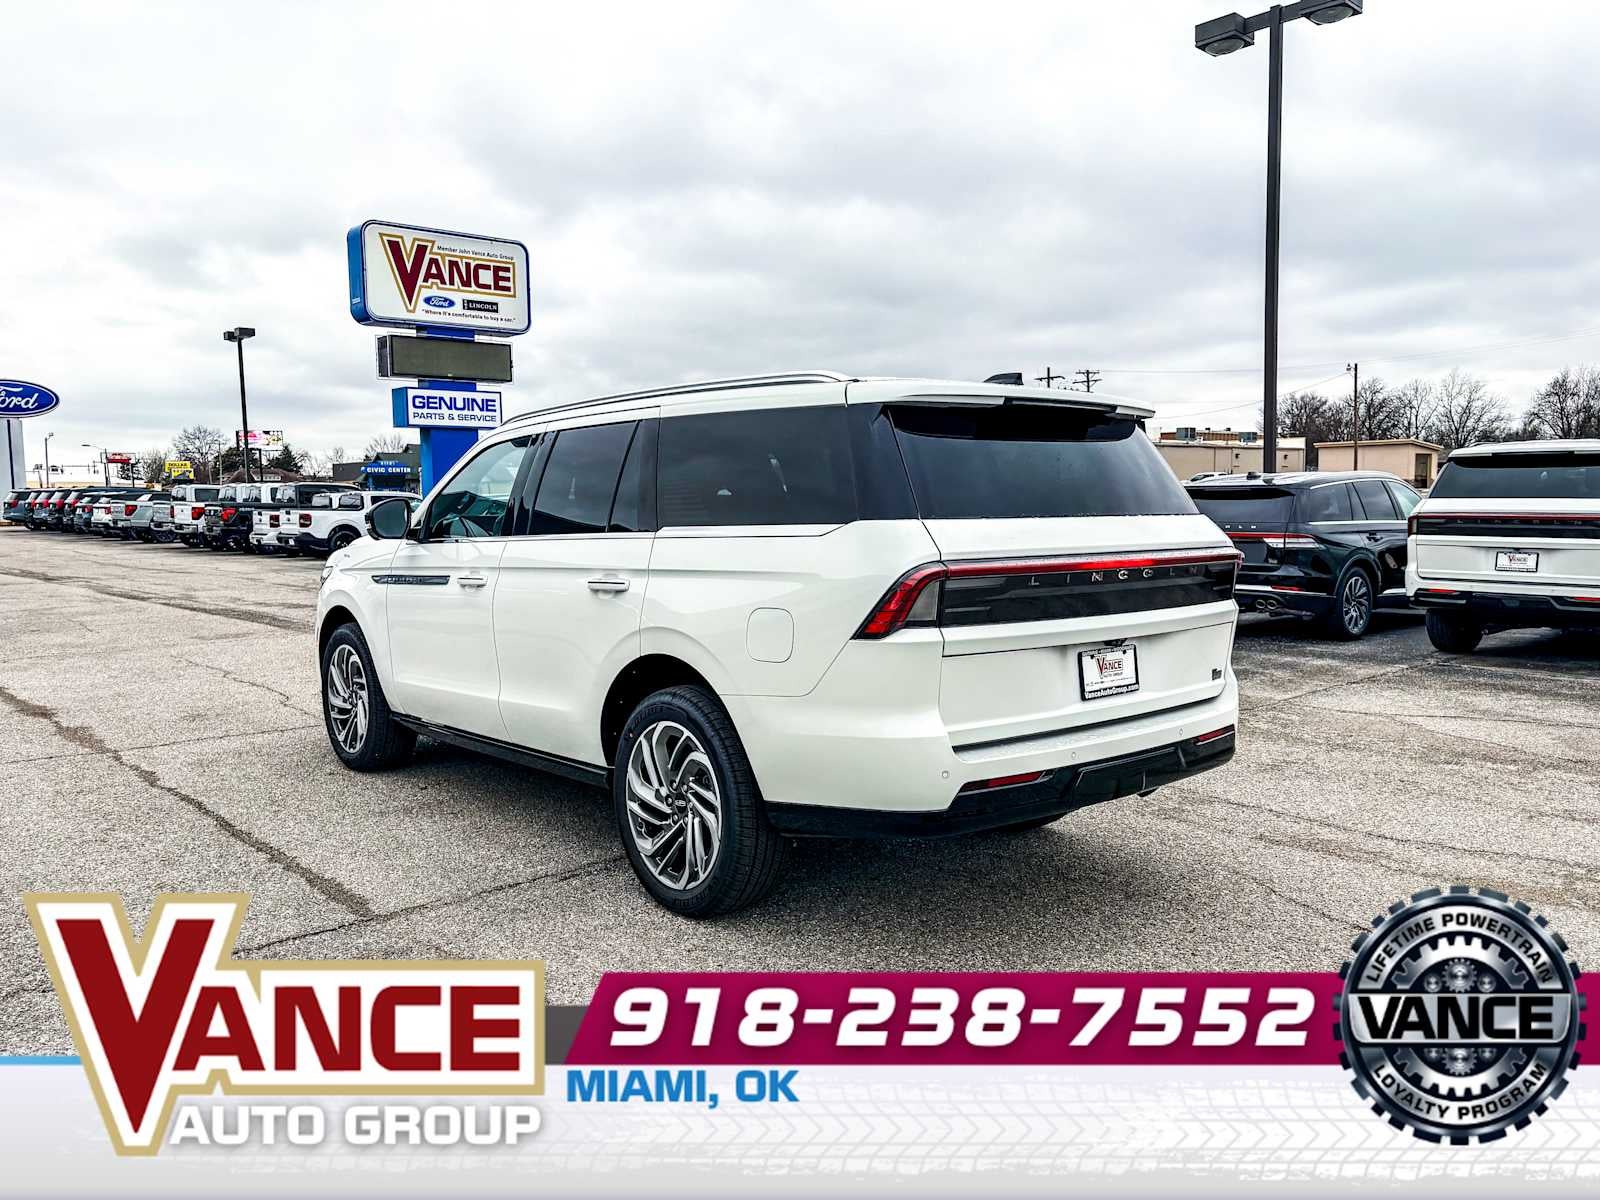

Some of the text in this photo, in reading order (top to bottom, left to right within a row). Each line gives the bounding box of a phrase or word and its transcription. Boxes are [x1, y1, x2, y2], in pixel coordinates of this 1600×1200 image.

[437, 245, 458, 253] Member
[499, 253, 514, 261] Group
[386, 240, 512, 307] VANCE
[468, 302, 497, 310] LINCOLN
[451, 312, 483, 320] comfortable
[412, 395, 497, 412] GENUINE
[413, 412, 497, 422] PARTS & SERVICE
[1096, 656, 1123, 676] VANCE
[1084, 684, 1140, 699] VanceAutoGroup.com
